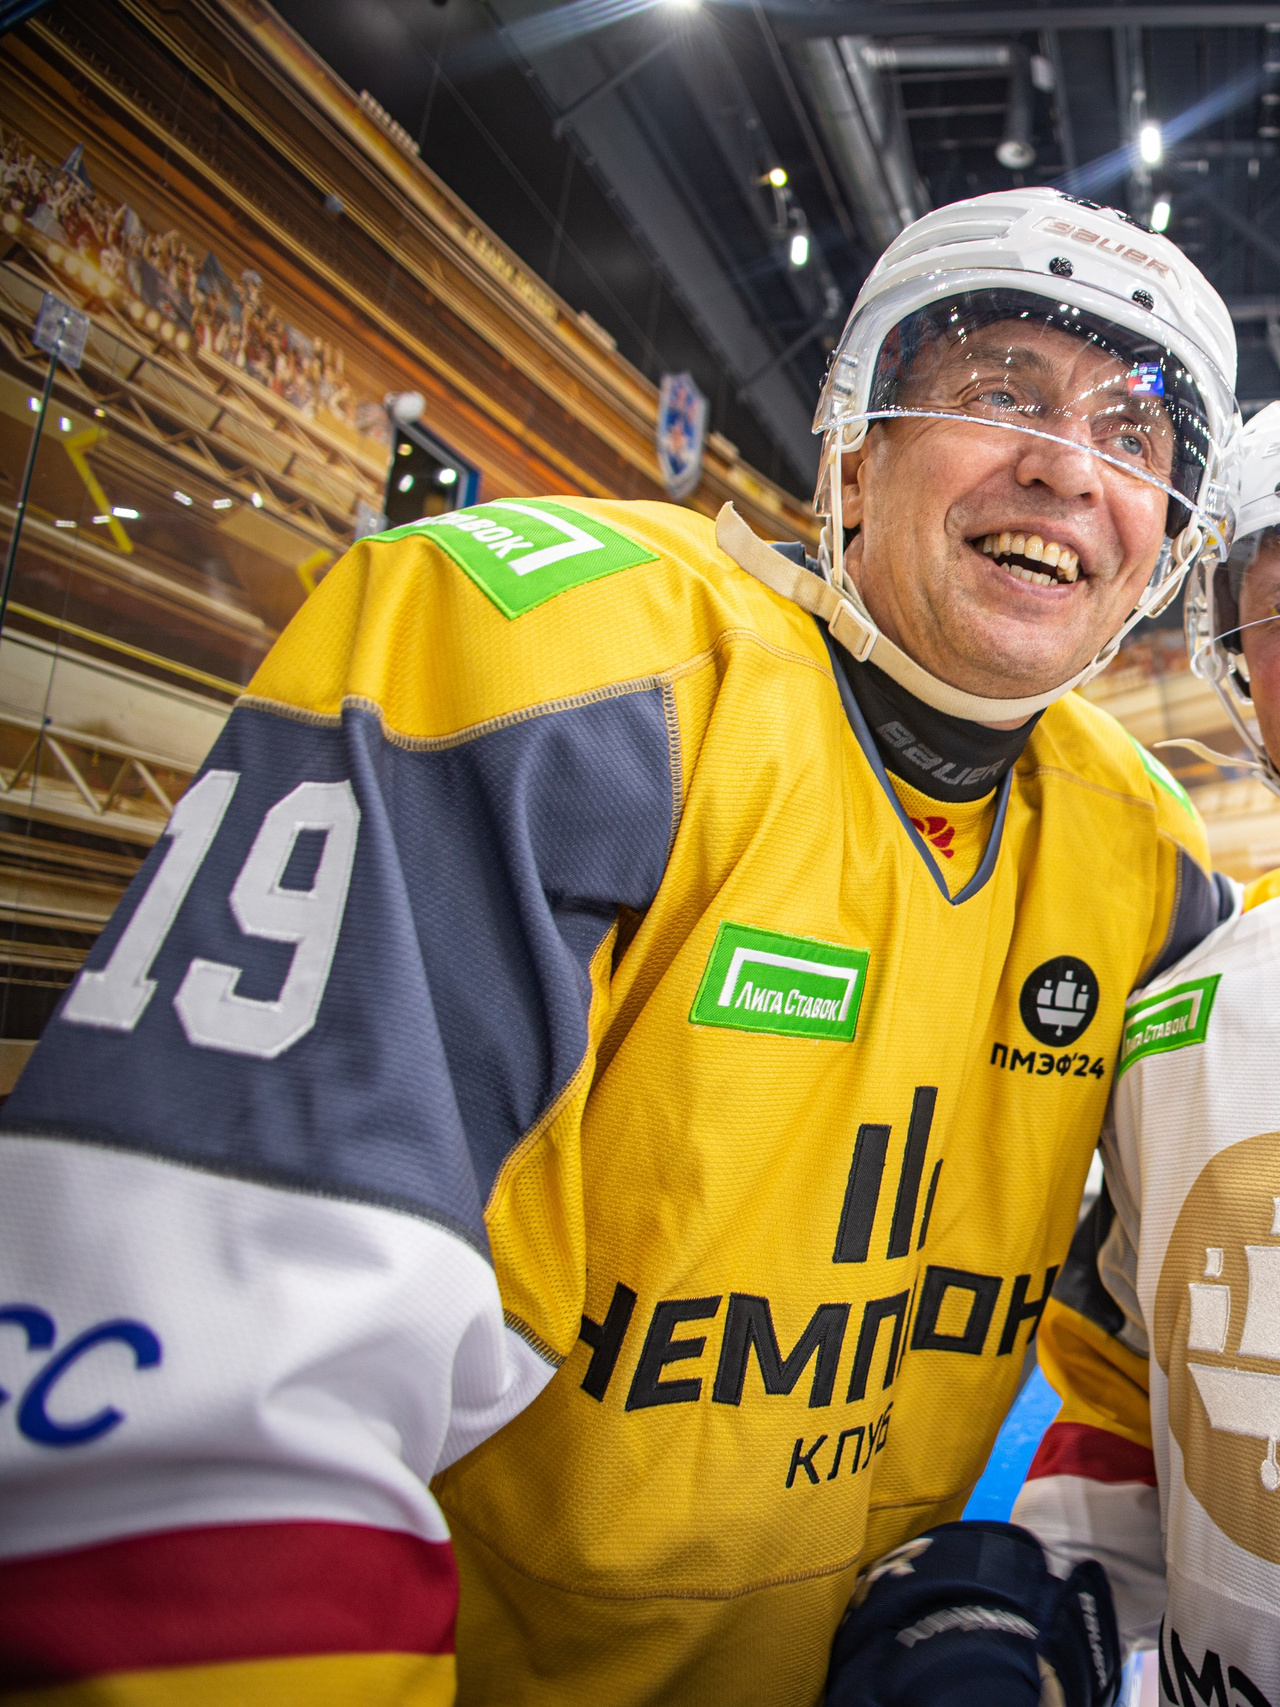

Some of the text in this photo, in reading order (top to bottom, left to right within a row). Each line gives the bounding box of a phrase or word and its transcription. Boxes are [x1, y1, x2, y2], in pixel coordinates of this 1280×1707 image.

[1043, 221, 1171, 279] BAUER
[876, 720, 1007, 786] BAUER
[60, 769, 361, 1060] 19
[578, 1264, 1061, 1412] ЧЕМПОН
[785, 1401, 894, 1489] КЛУБ
